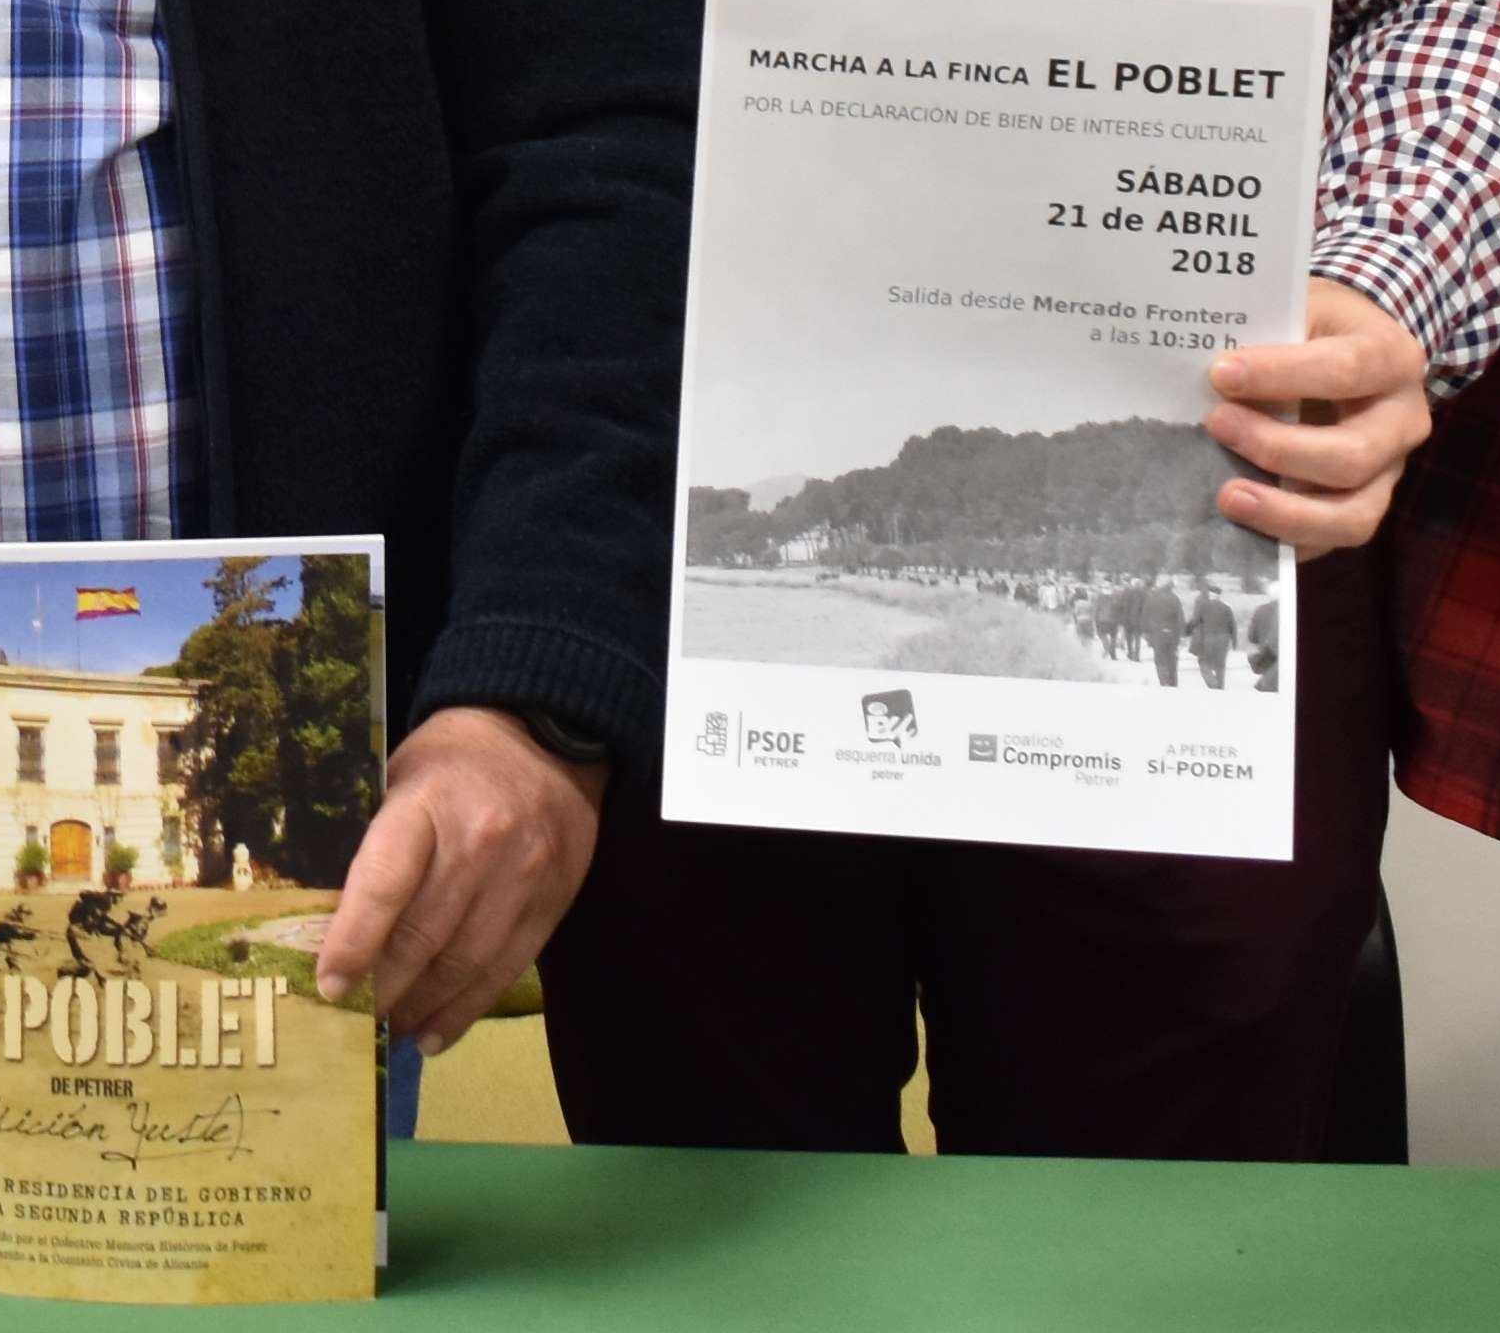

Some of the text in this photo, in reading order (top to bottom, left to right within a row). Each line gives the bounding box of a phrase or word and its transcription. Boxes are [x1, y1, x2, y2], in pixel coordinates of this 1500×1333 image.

[750, 49, 1286, 99] MARCHA A LA FINCA EL POBLET
[744, 96, 783, 113] POR
[791, 99, 813, 115] LA
[965, 110, 991, 127] DE
[998, 112, 1042, 130] BIEN
[1050, 116, 1076, 133] DE
[1171, 123, 1268, 143] CULTURAL
[1116, 165, 1262, 200] SÁBADO
[1047, 203, 1258, 238] 21 de ABRIL
[1171, 248, 1256, 276] 2018
[888, 286, 1248, 325] Salida desde Mercado Frontera
[1089, 328, 1102, 341] a
[1110, 326, 1140, 345] las
[1148, 330, 1215, 350] 10:30
[747, 730, 806, 754] PSOE
[836, 747, 942, 766] esquerra unida
[4, 975, 288, 1067] POBLET
[51, 1077, 134, 1098] DE PETRER
[4, 1177, 136, 1201] RESIDENCIA
[147, 1187, 188, 1203] DEL
[200, 1186, 312, 1203] GOBIERNO
[15, 1203, 106, 1224] SEGUNDA
[120, 1207, 244, 1227] REPÚBLICA
